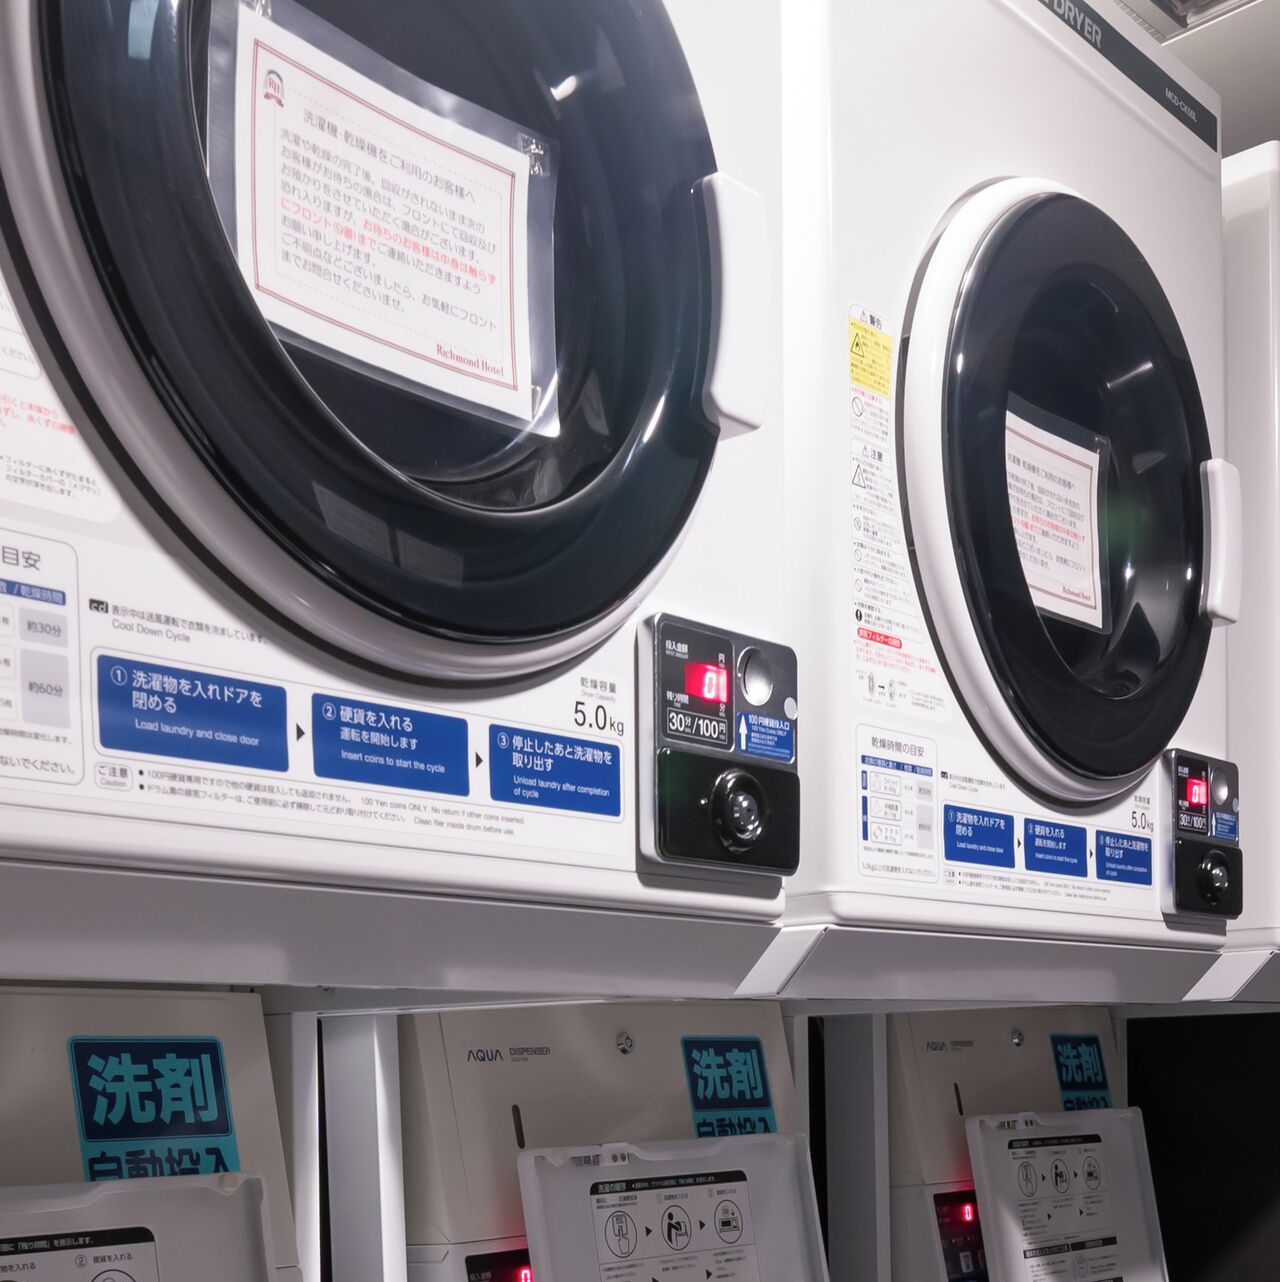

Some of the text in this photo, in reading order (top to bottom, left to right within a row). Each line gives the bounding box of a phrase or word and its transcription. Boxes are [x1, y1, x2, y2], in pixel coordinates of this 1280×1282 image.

[1053, 0, 1103, 49] DRYER
[436, 343, 505, 377] Richmond Hotel
[27, 620, 61, 638] 約30分
[112, 619, 191, 644] Cool Down Cycle
[28, 680, 63, 698] 約60分
[132, 669, 262, 709] 洗濯物を入れドアを
[580, 677, 616, 693] 乾燥容量
[131, 689, 177, 714] 閉める
[340, 705, 413, 732] 硬貨を入れる
[135, 718, 260, 747] Load laundry and close door
[340, 727, 418, 751] 運転を開始します
[512, 735, 611, 765] 停止したあと洗濯物を
[871, 735, 925, 757] 乾燥時間の目安
[98, 764, 129, 779] ご注意
[341, 749, 444, 774] Insert coins to start the cycle
[512, 752, 553, 772] 取り出す
[513, 775, 609, 798] Unload laundry after completion
[514, 786, 538, 799] of cycle
[467, 1047, 551, 1062] AQUA DISPENSER
[1057, 1043, 1103, 1084] 洗剤
[691, 1048, 764, 1100] 洗剤
[87, 1052, 220, 1126] 洗剤
